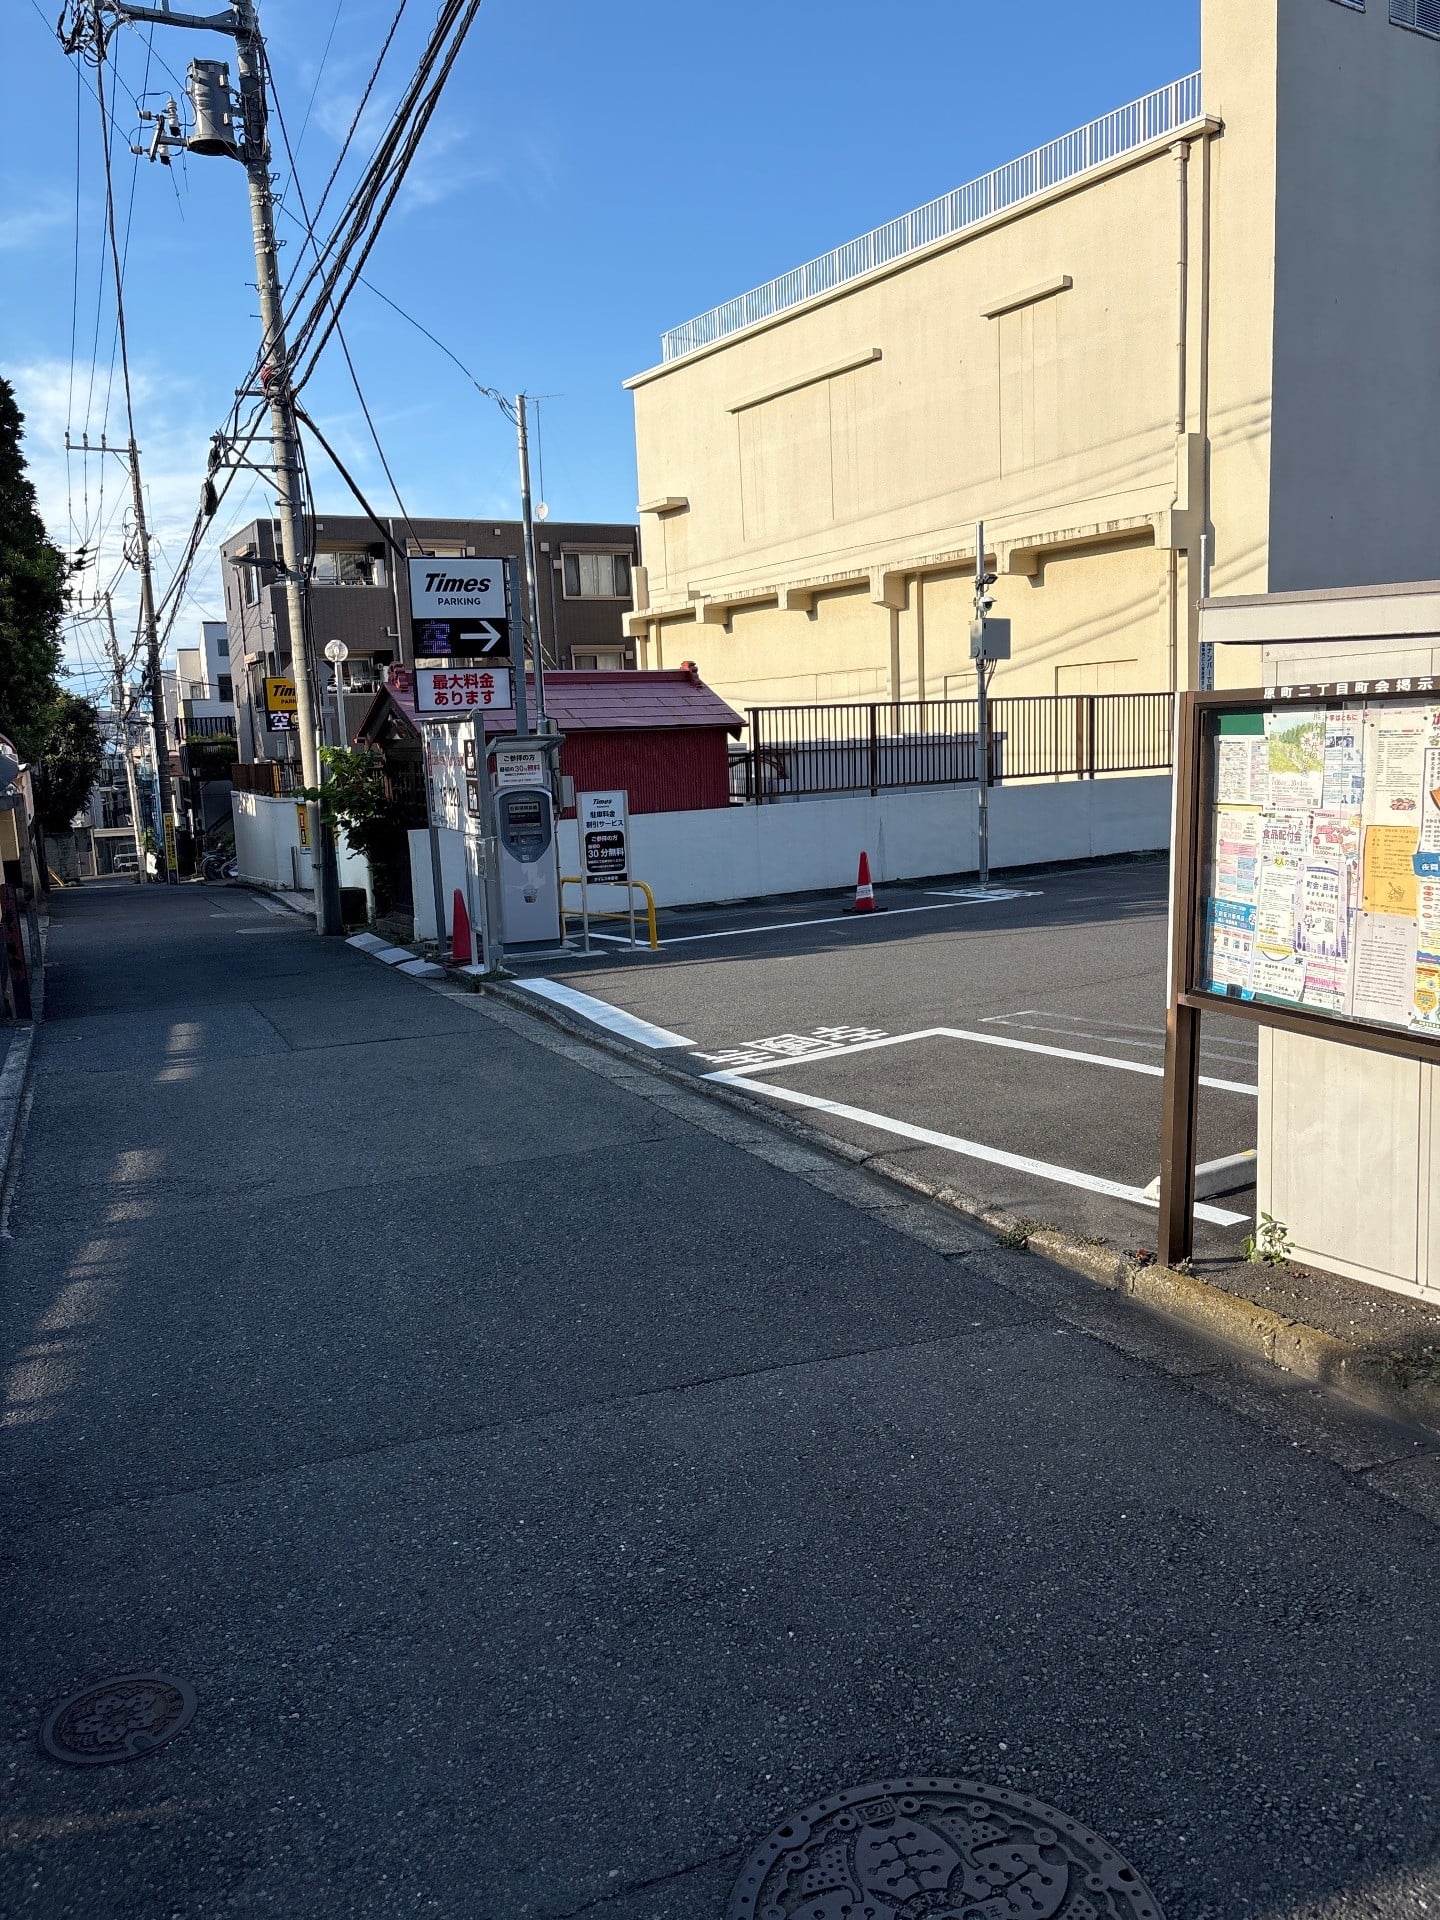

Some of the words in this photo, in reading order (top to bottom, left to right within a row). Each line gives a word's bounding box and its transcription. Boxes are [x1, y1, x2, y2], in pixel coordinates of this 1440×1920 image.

[425, 573, 491, 593] Times
[438, 597, 481, 606] PARKING
[432, 673, 495, 690] 最大料金
[1263, 676, 1434, 700] 原町二丁目町会掲示
[273, 684, 296, 697] Tim
[434, 690, 495, 706] あります
[270, 711, 291, 731] 空
[586, 819, 624, 829] 割引サービス
